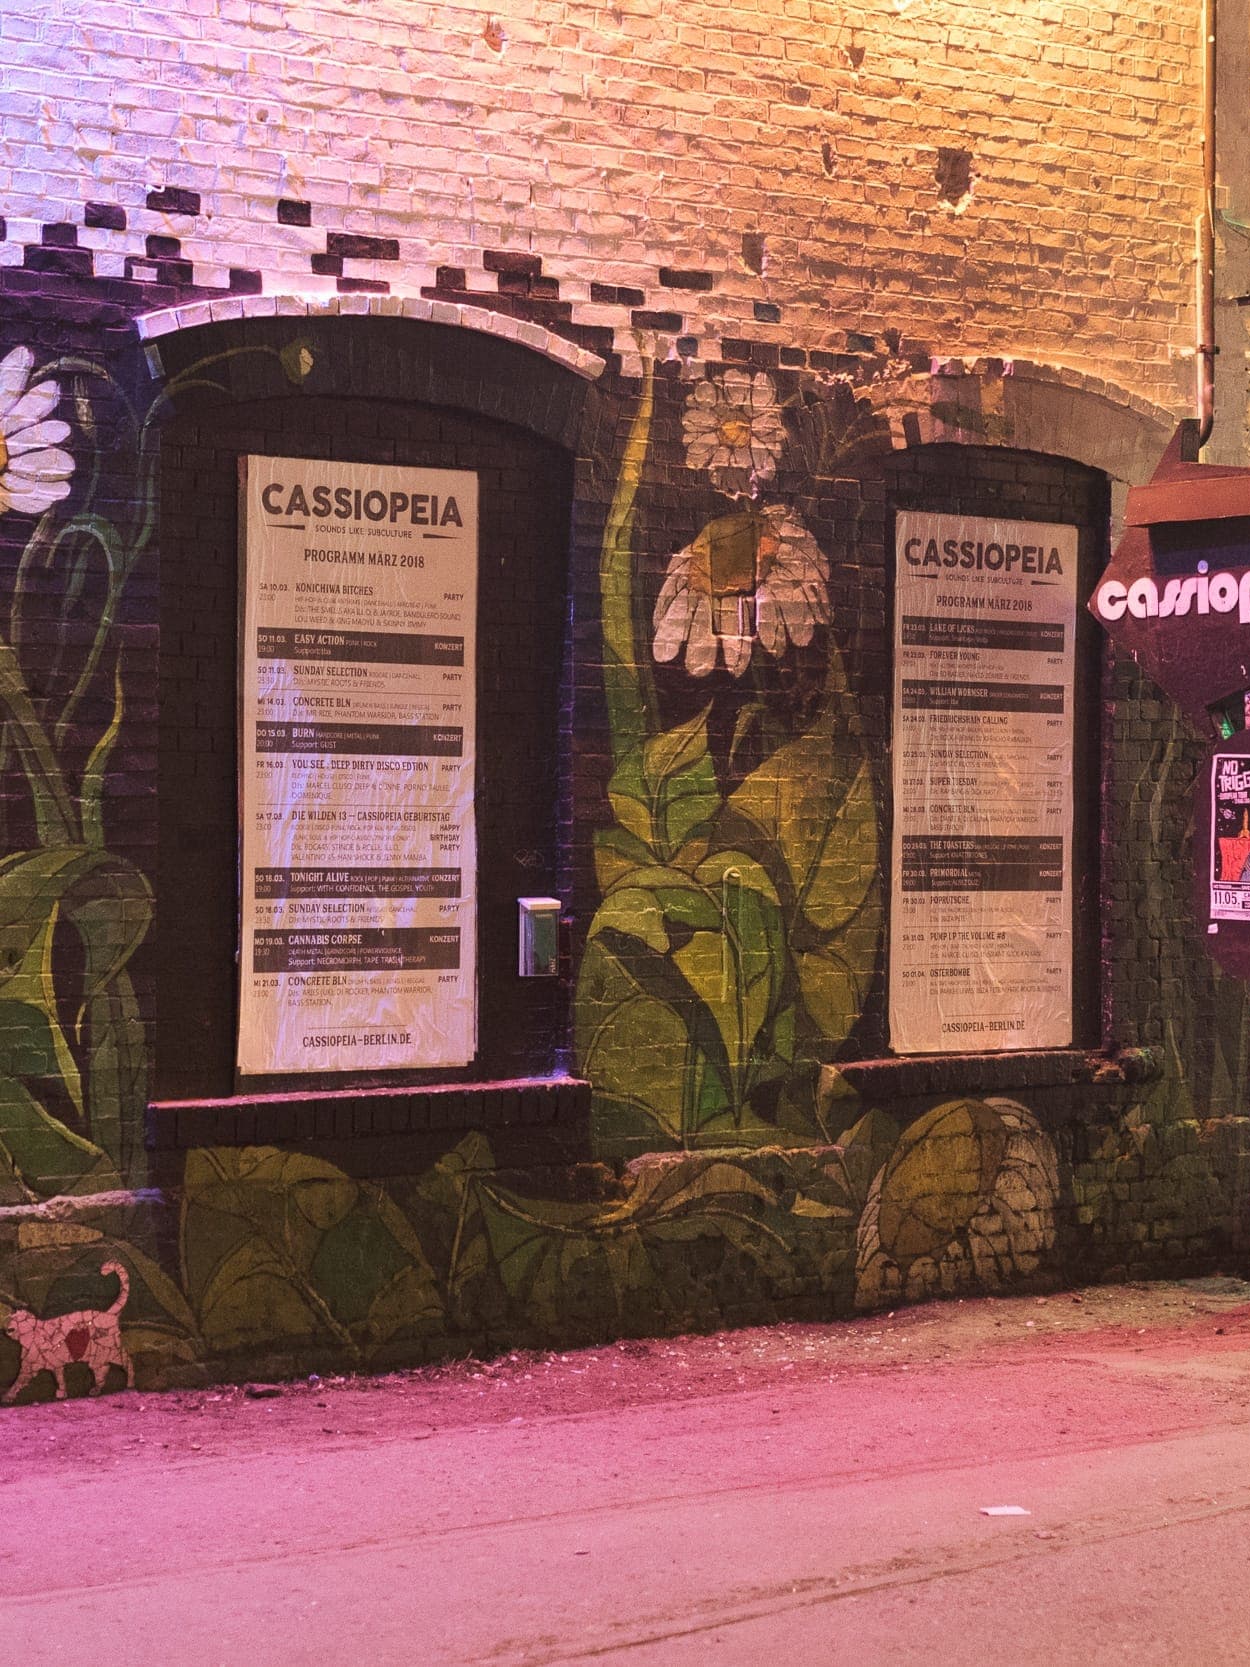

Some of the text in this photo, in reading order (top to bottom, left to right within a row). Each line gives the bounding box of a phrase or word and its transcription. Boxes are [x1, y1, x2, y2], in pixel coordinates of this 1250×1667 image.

[262, 483, 463, 528] CASSIOPEIA
[315, 524, 412, 539] SOUNDS LIKE SUBCULTURE
[304, 549, 425, 568] PROGRAMM MÄRZ 2018
[904, 538, 1063, 575] CASSIOPEIA
[295, 583, 341, 594] KONICHIWA
[342, 584, 374, 596] BITCHES
[443, 593, 464, 601] PARTY
[936, 595, 1033, 611] PROGRAMM MÄRZ 2018
[295, 634, 315, 644] EASY
[317, 635, 345, 646] ACTION
[929, 651, 980, 661] FOREVER YOUNG
[294, 665, 324, 676] SUNDAY
[326, 666, 368, 677] SELECTION
[442, 673, 462, 681] PARTY
[293, 696, 333, 707] CONCRETE
[335, 698, 351, 708] BLN
[982, 716, 1008, 724] CALLING
[292, 728, 314, 738] BURN
[955, 750, 988, 759] SELECTION
[292, 760, 309, 770] YOU
[310, 760, 325, 770] SEE
[331, 760, 350, 770] DEEP
[352, 761, 375, 770] DIRTY
[376, 761, 400, 771] DISCO
[441, 764, 461, 772] PARTY
[1222, 760, 1239, 776] NO
[929, 777, 950, 786] SUPER
[291, 811, 306, 820] DIE
[307, 811, 337, 821] WILDEN
[339, 811, 347, 820] 13
[357, 811, 402, 821] CASSIOPEIA
[404, 811, 450, 821] GEBURTSTAG
[290, 872, 324, 882] TONIGHT
[326, 872, 350, 882] ALIVE
[929, 868, 968, 877] PRIMORDIAL
[1214, 891, 1240, 905] 11.05.
[289, 904, 321, 914] SUNDAY
[322, 903, 365, 913] SELECTION
[288, 935, 329, 945] CANNABIS
[331, 935, 363, 944] CORPSE
[429, 935, 459, 943] KONZERT
[930, 932, 947, 940] PUMP
[288, 976, 331, 986] CONCRETE
[332, 976, 347, 985] BLN
[438, 975, 459, 983] PARTY
[942, 1020, 1025, 1033] CASSIOPEIA-BERLIN.DE
[302, 1033, 411, 1048] CASSIOPEIA-BERLIN.DE
